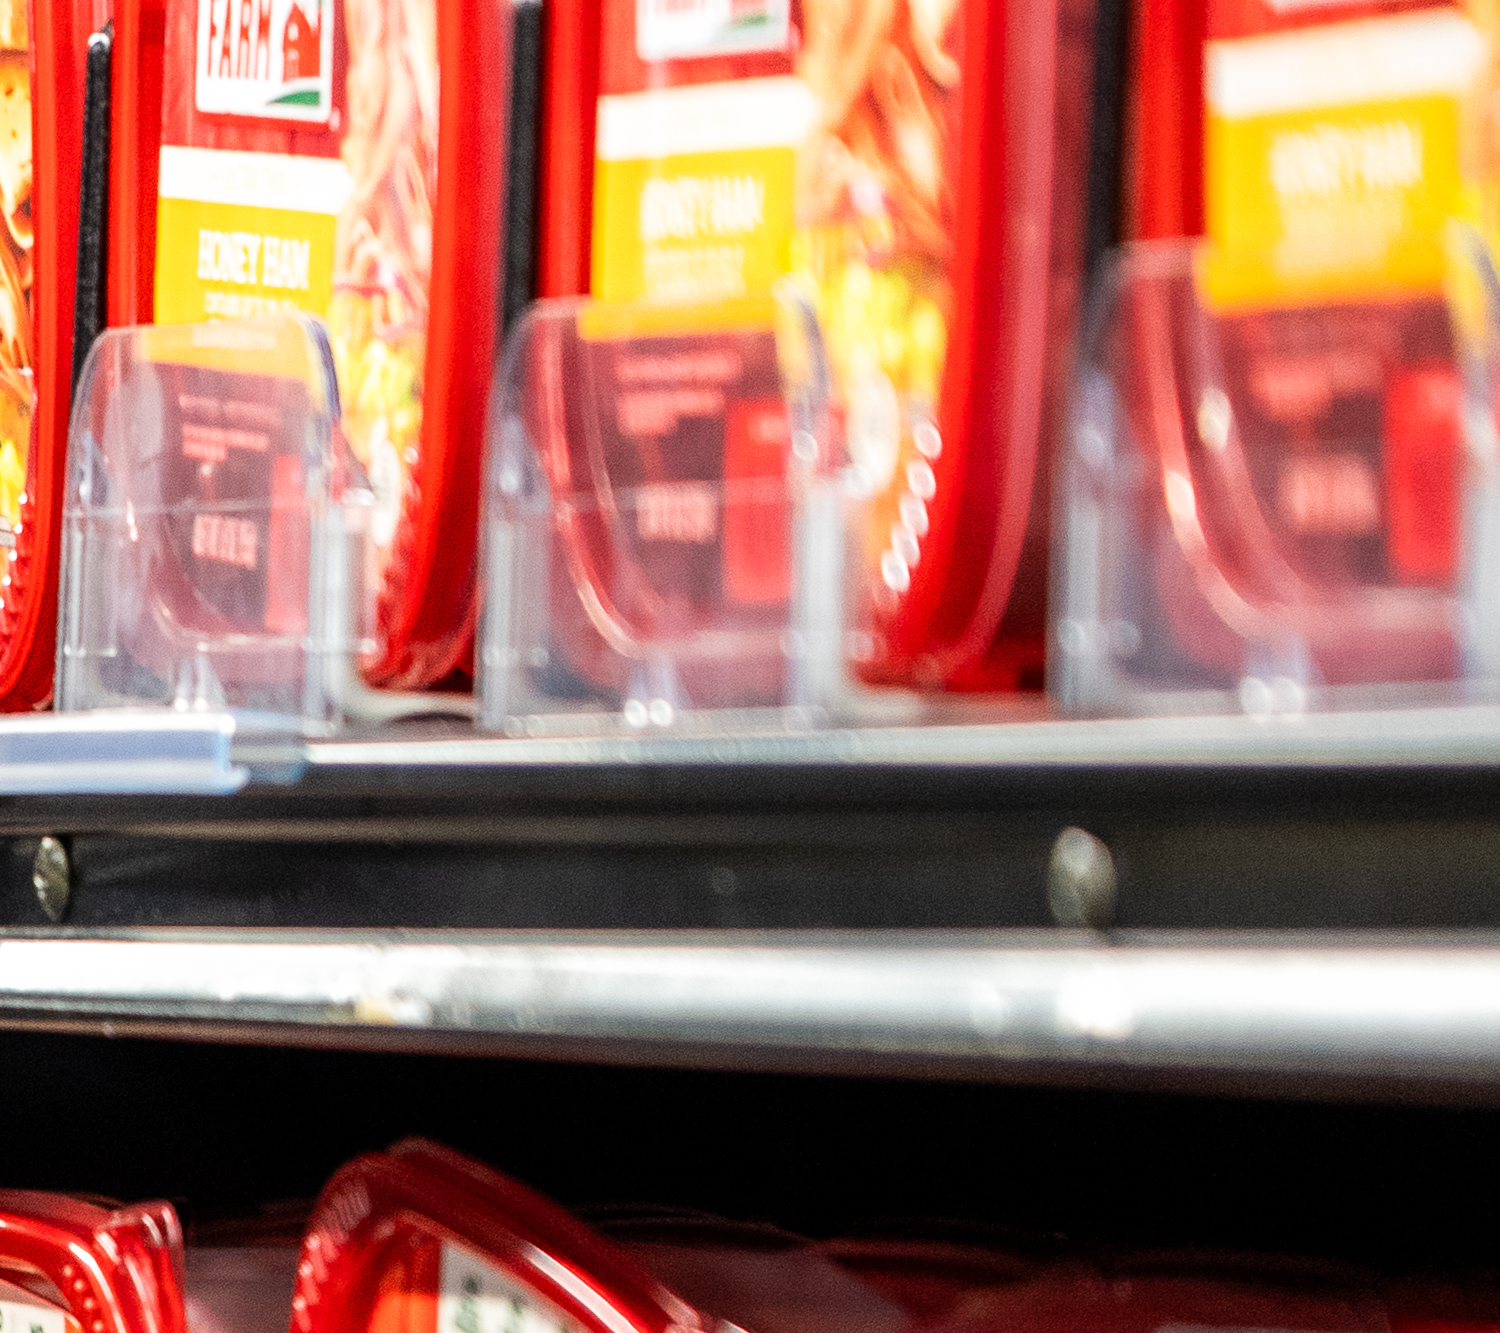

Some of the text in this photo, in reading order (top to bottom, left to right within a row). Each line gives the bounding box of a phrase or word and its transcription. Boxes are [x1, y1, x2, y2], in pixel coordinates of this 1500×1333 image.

[206, 0, 271, 80] FARM
[197, 228, 310, 290] HONEY HAM
